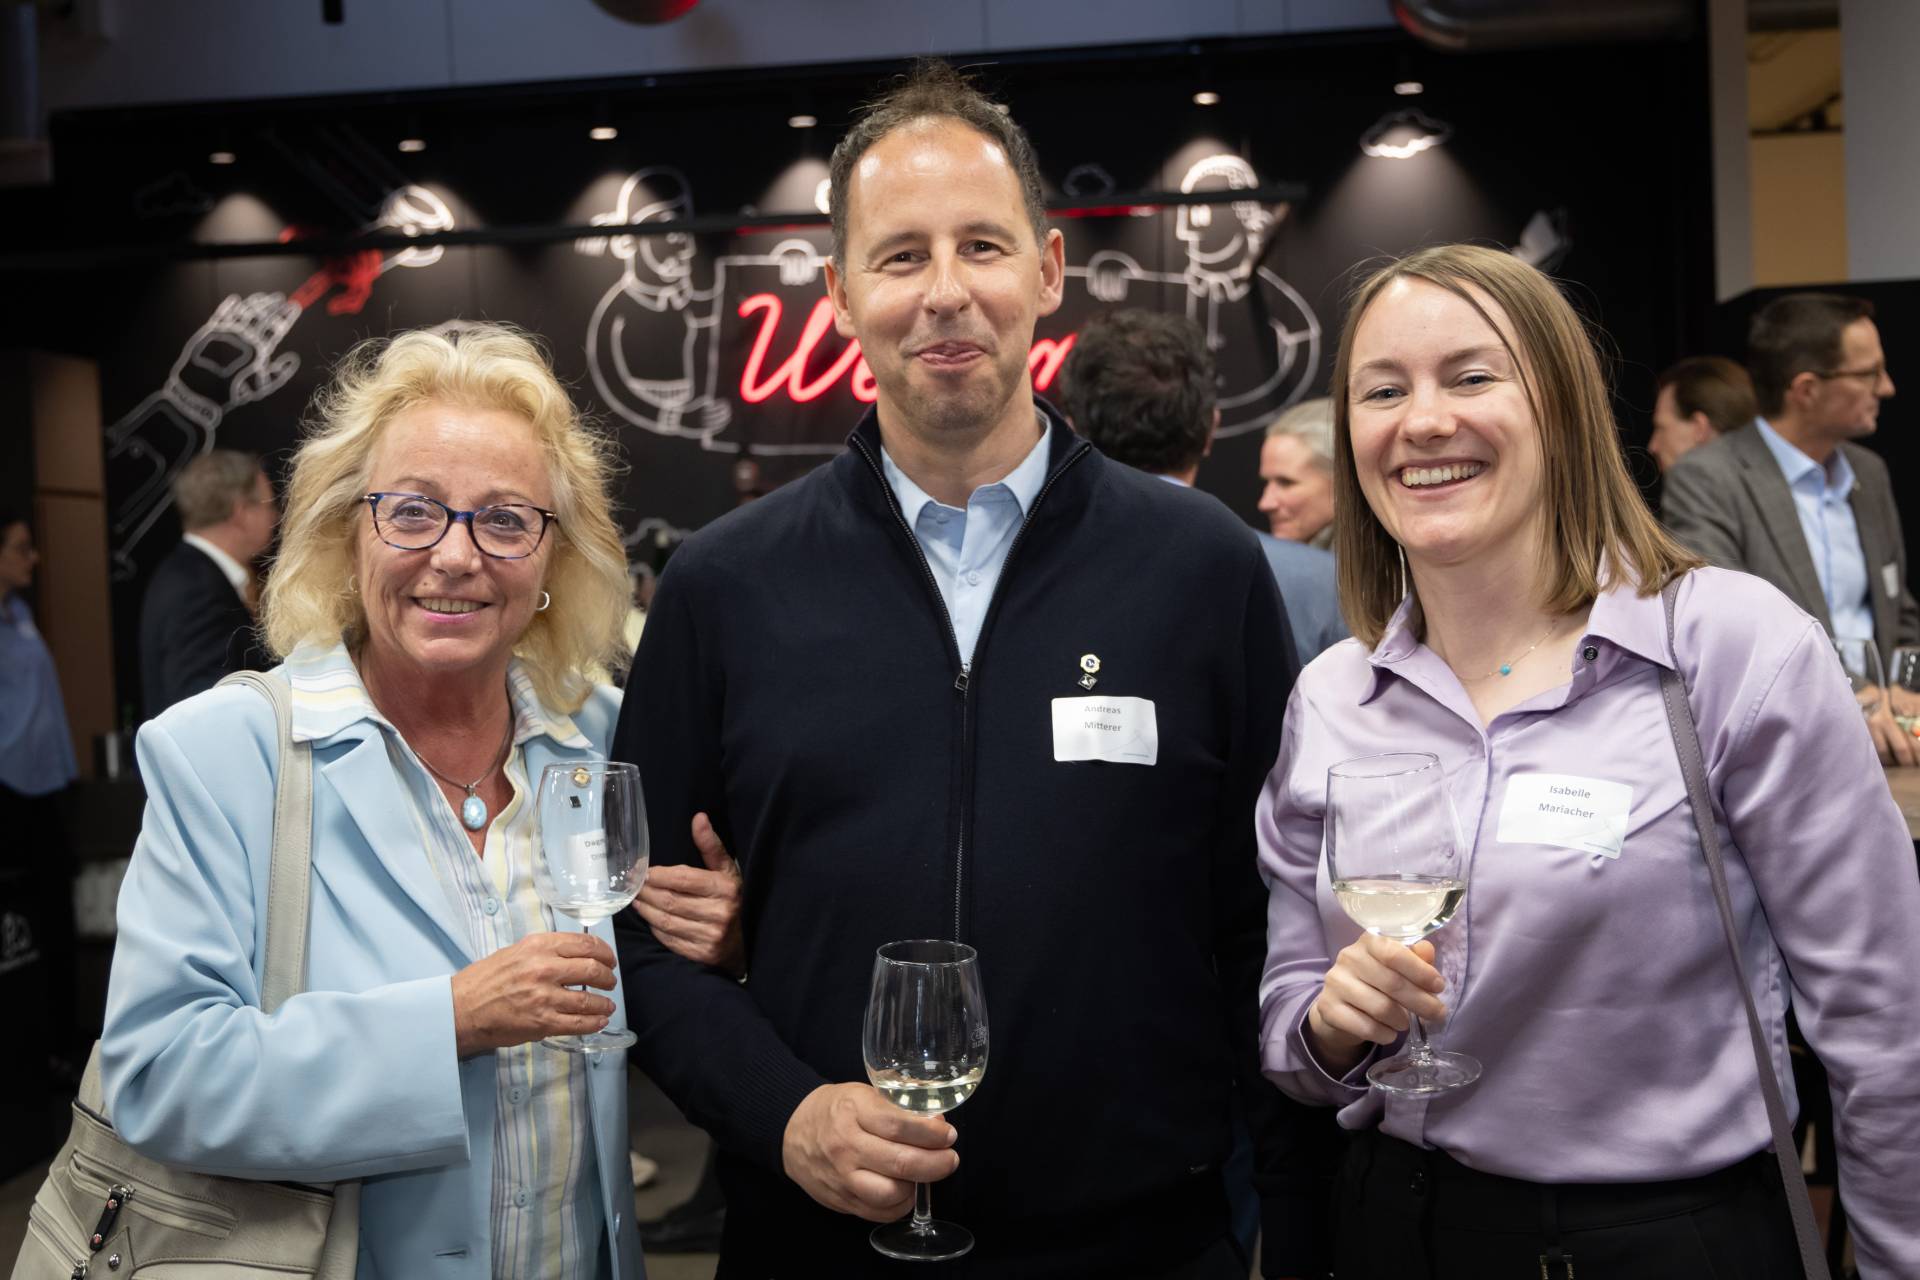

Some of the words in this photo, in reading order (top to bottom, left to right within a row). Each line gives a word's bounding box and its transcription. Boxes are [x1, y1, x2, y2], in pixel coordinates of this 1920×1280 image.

[1084, 705, 1121, 714] Andreas
[1084, 722, 1122, 732] Mitterer
[1549, 785, 1591, 799] Isabelle
[1538, 803, 1595, 819] Mariacher
